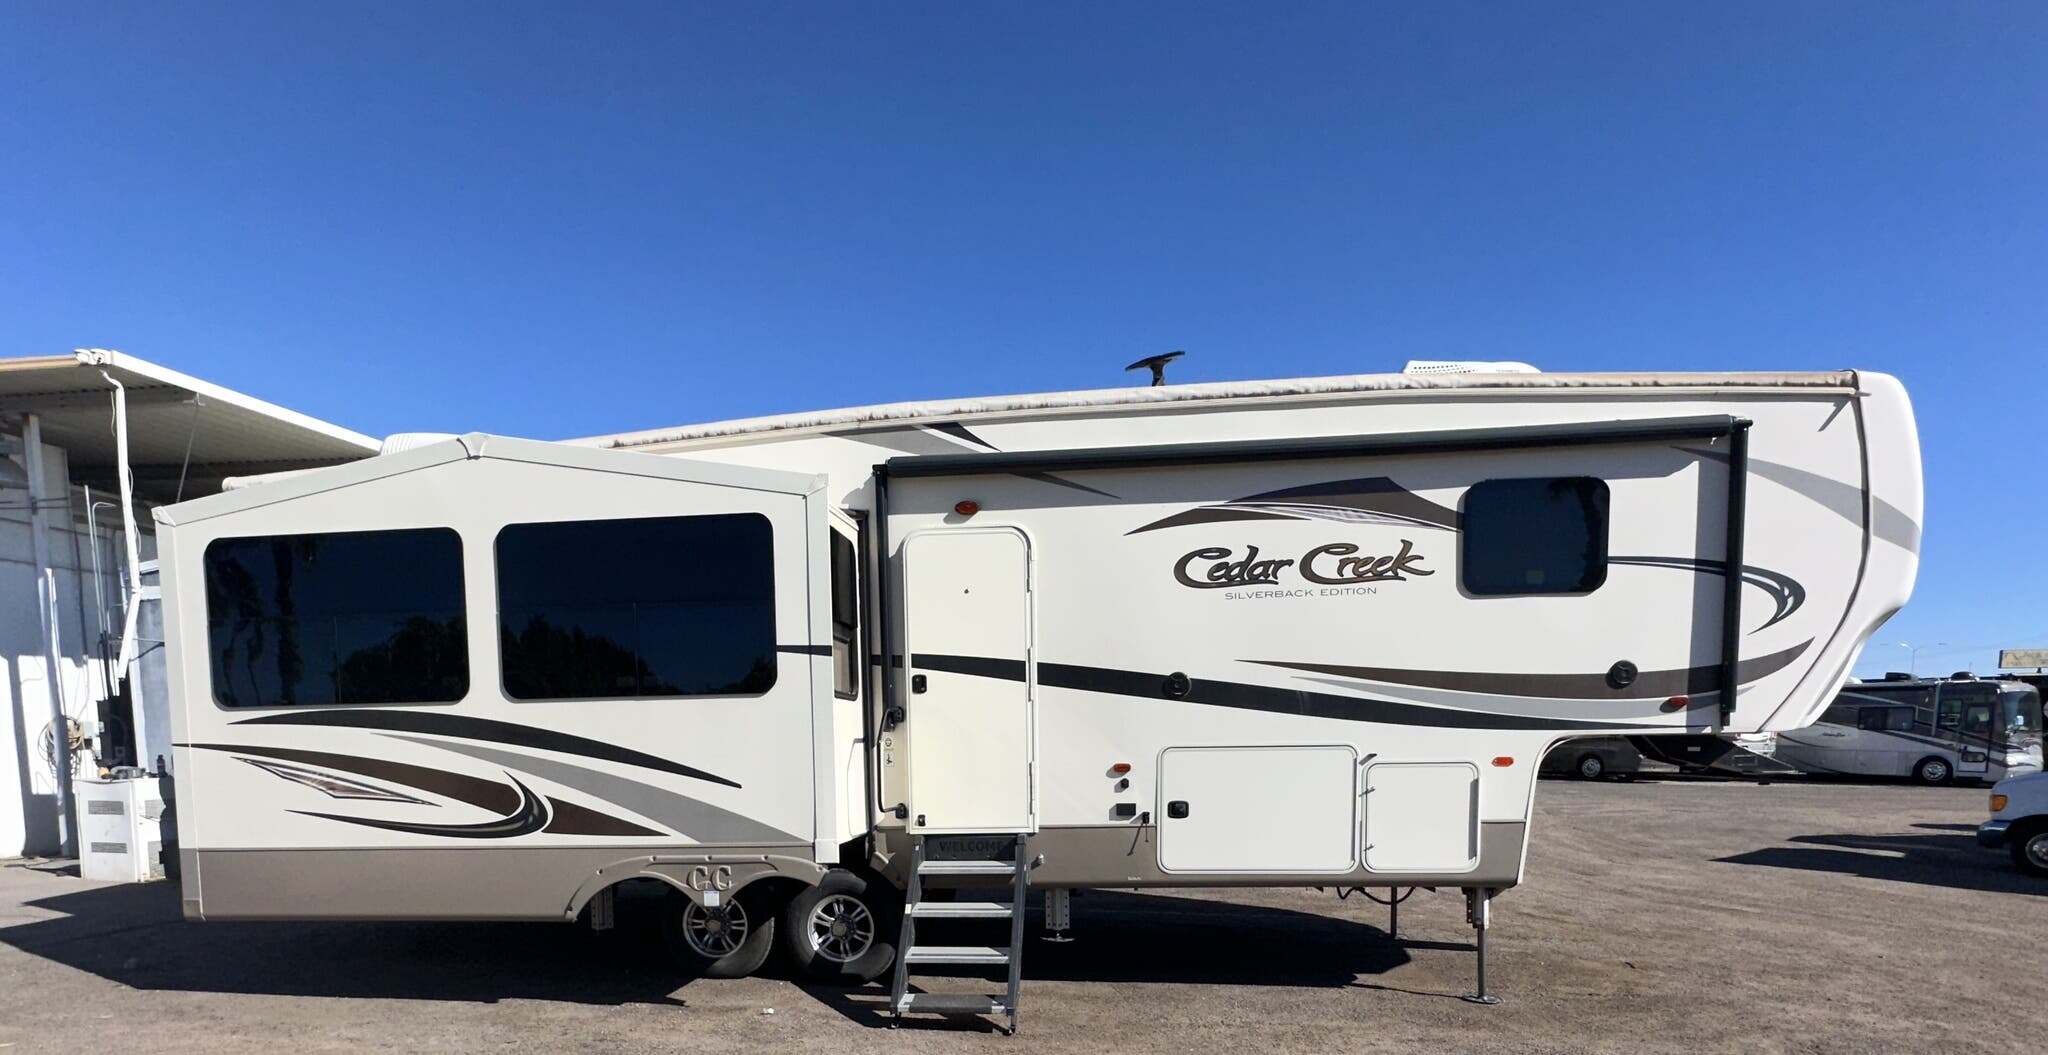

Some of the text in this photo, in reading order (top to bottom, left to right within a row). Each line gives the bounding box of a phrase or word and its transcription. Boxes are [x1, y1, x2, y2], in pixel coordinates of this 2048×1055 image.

[1174, 538, 1435, 589] Cedar Creek
[1224, 586, 1377, 600] SILVERBACK EDITION
[937, 839, 1004, 853] WELCOME
